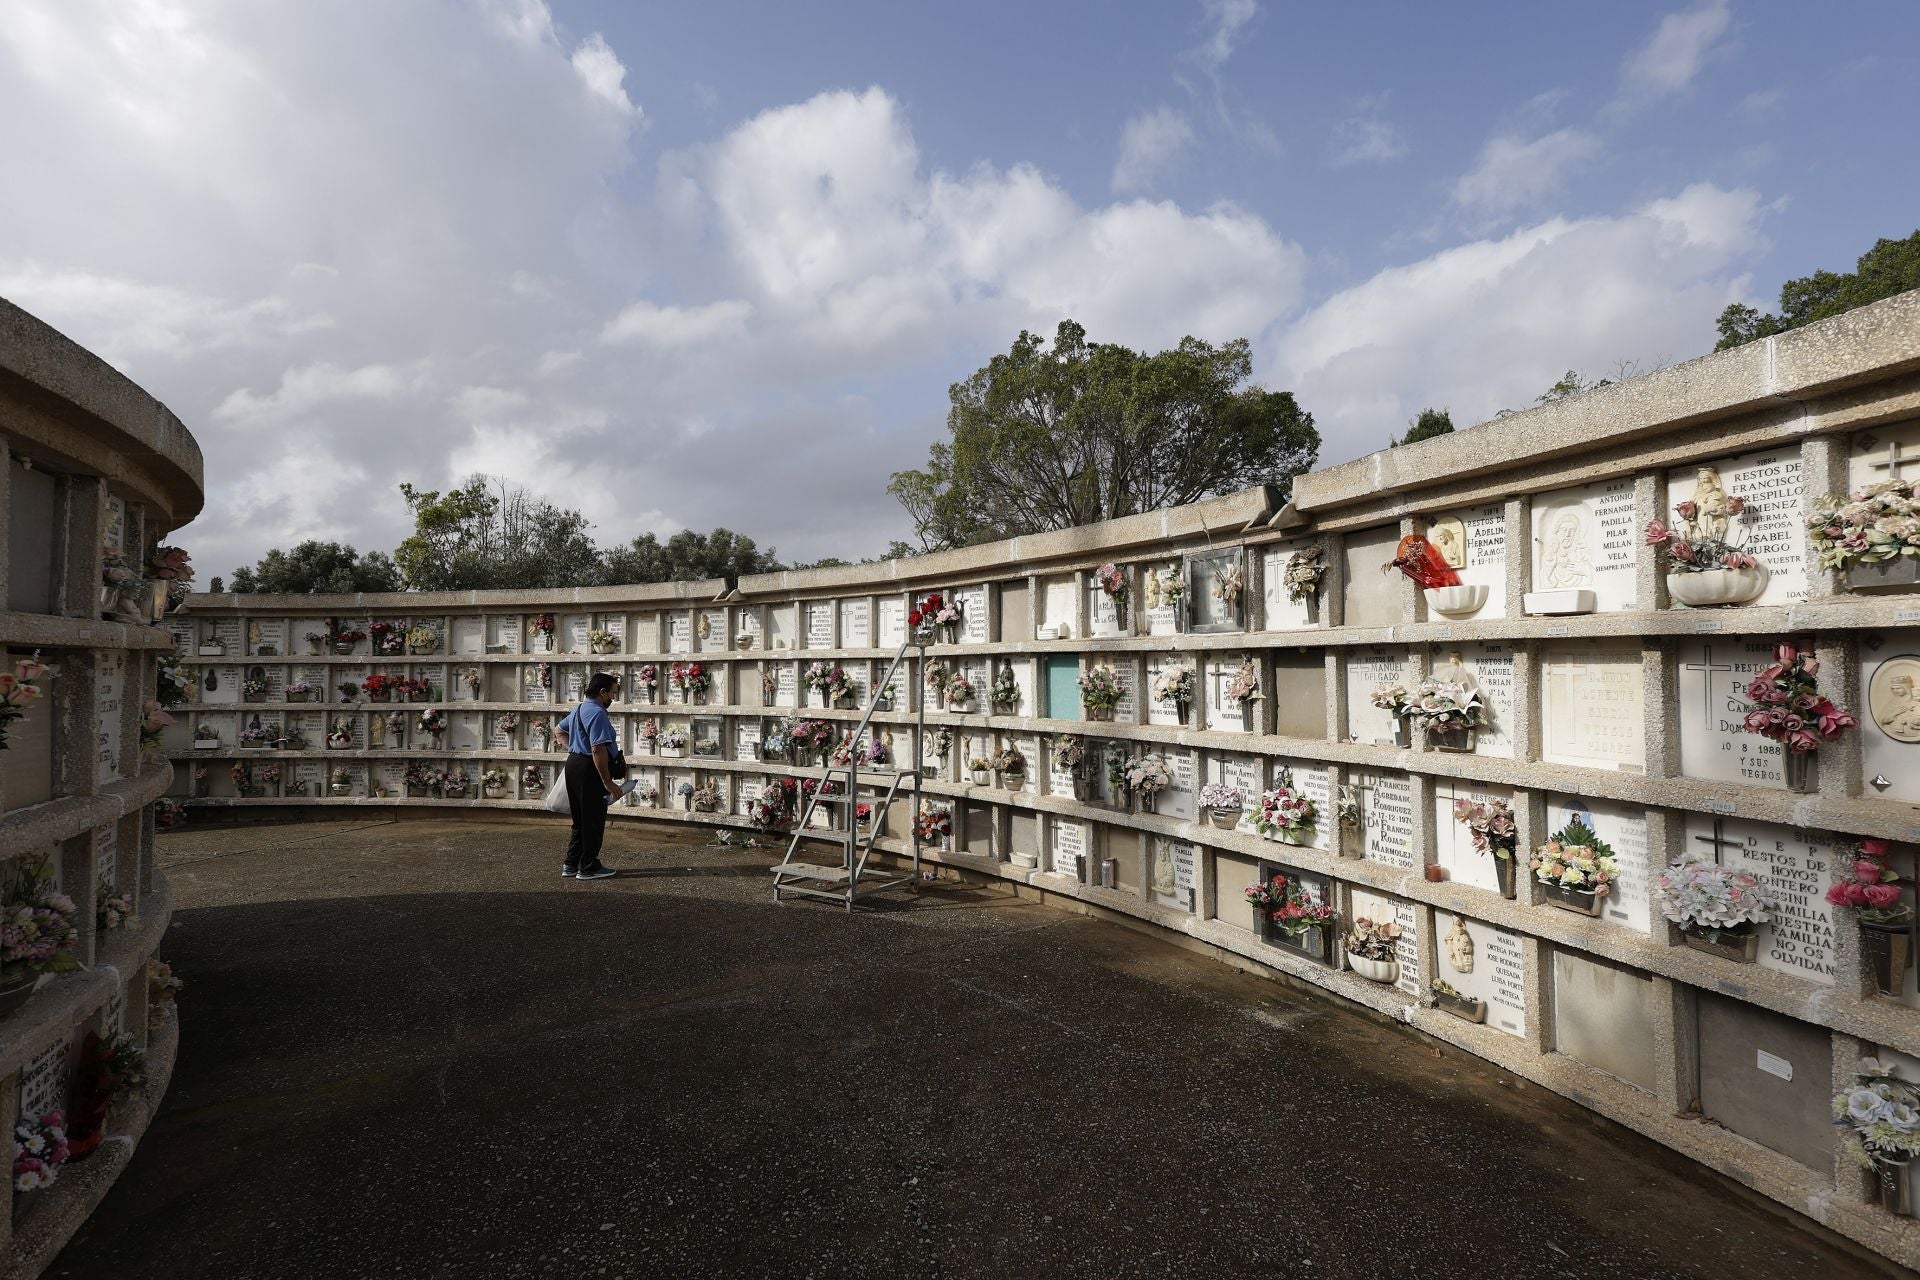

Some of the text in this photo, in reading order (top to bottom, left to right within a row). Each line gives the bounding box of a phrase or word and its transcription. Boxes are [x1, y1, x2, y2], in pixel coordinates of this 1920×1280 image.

[1734, 462, 1802, 482] RESTOS DE
[1732, 474, 1804, 493] FRANCISCO
[1599, 493, 1634, 505] ANTONIO
[1740, 486, 1804, 505] RESPILLO
[1594, 504, 1636, 517] FERNANDE
[1743, 499, 1798, 515] JIMENEZ
[1467, 515, 1506, 528] RESTOS DE
[1601, 516, 1633, 528] PADILLA
[1737, 517, 1749, 526] SU
[1757, 521, 1793, 532] ESPOSA
[1474, 526, 1506, 538] ADELIN
[1606, 529, 1628, 539] PILAR
[1748, 530, 1792, 544] ISABEL
[1467, 536, 1505, 548] HERNAND
[1602, 540, 1632, 550] MILLAN
[1477, 547, 1506, 558] RAMOS
[1746, 543, 1790, 555] BURGO
[1607, 553, 1628, 561] VELA
[1595, 565, 1619, 573] SIEMPRE
[1371, 663, 1405, 672] MANUEL
[1475, 658, 1513, 667] RESTOS DE
[1478, 667, 1511, 676] MANUEL
[1731, 681, 1747, 694] PE
[1721, 742, 1782, 756] 10 8 1988
[1739, 756, 1769, 767] Y SUS
[1373, 797, 1412, 816] RODRIGUEZ
[1380, 831, 1404, 848] ROJAS
[1371, 841, 1413, 861] MARMOLEJ
[1748, 836, 1817, 857] D E P
[1742, 848, 1826, 873] RESTOS DE
[1771, 865, 1818, 884] HOYOS
[1749, 872, 1819, 895] MONTERO
[1395, 907, 1413, 923] LUIS
[1772, 904, 1829, 923] AMILIA
[1496, 935, 1516, 948] MARIA
[1770, 925, 1833, 950] FAMILIA
[1486, 943, 1508, 955] ORTEGA
[1775, 938, 1824, 960] NO OS
[1487, 952, 1523, 971] JOSE RODRIGU
[1770, 949, 1835, 977] OLVIDAN
[1495, 966, 1521, 981] QUESADA
[1491, 975, 1507, 987] LUISA
[1498, 988, 1520, 1001] ORTEGA
